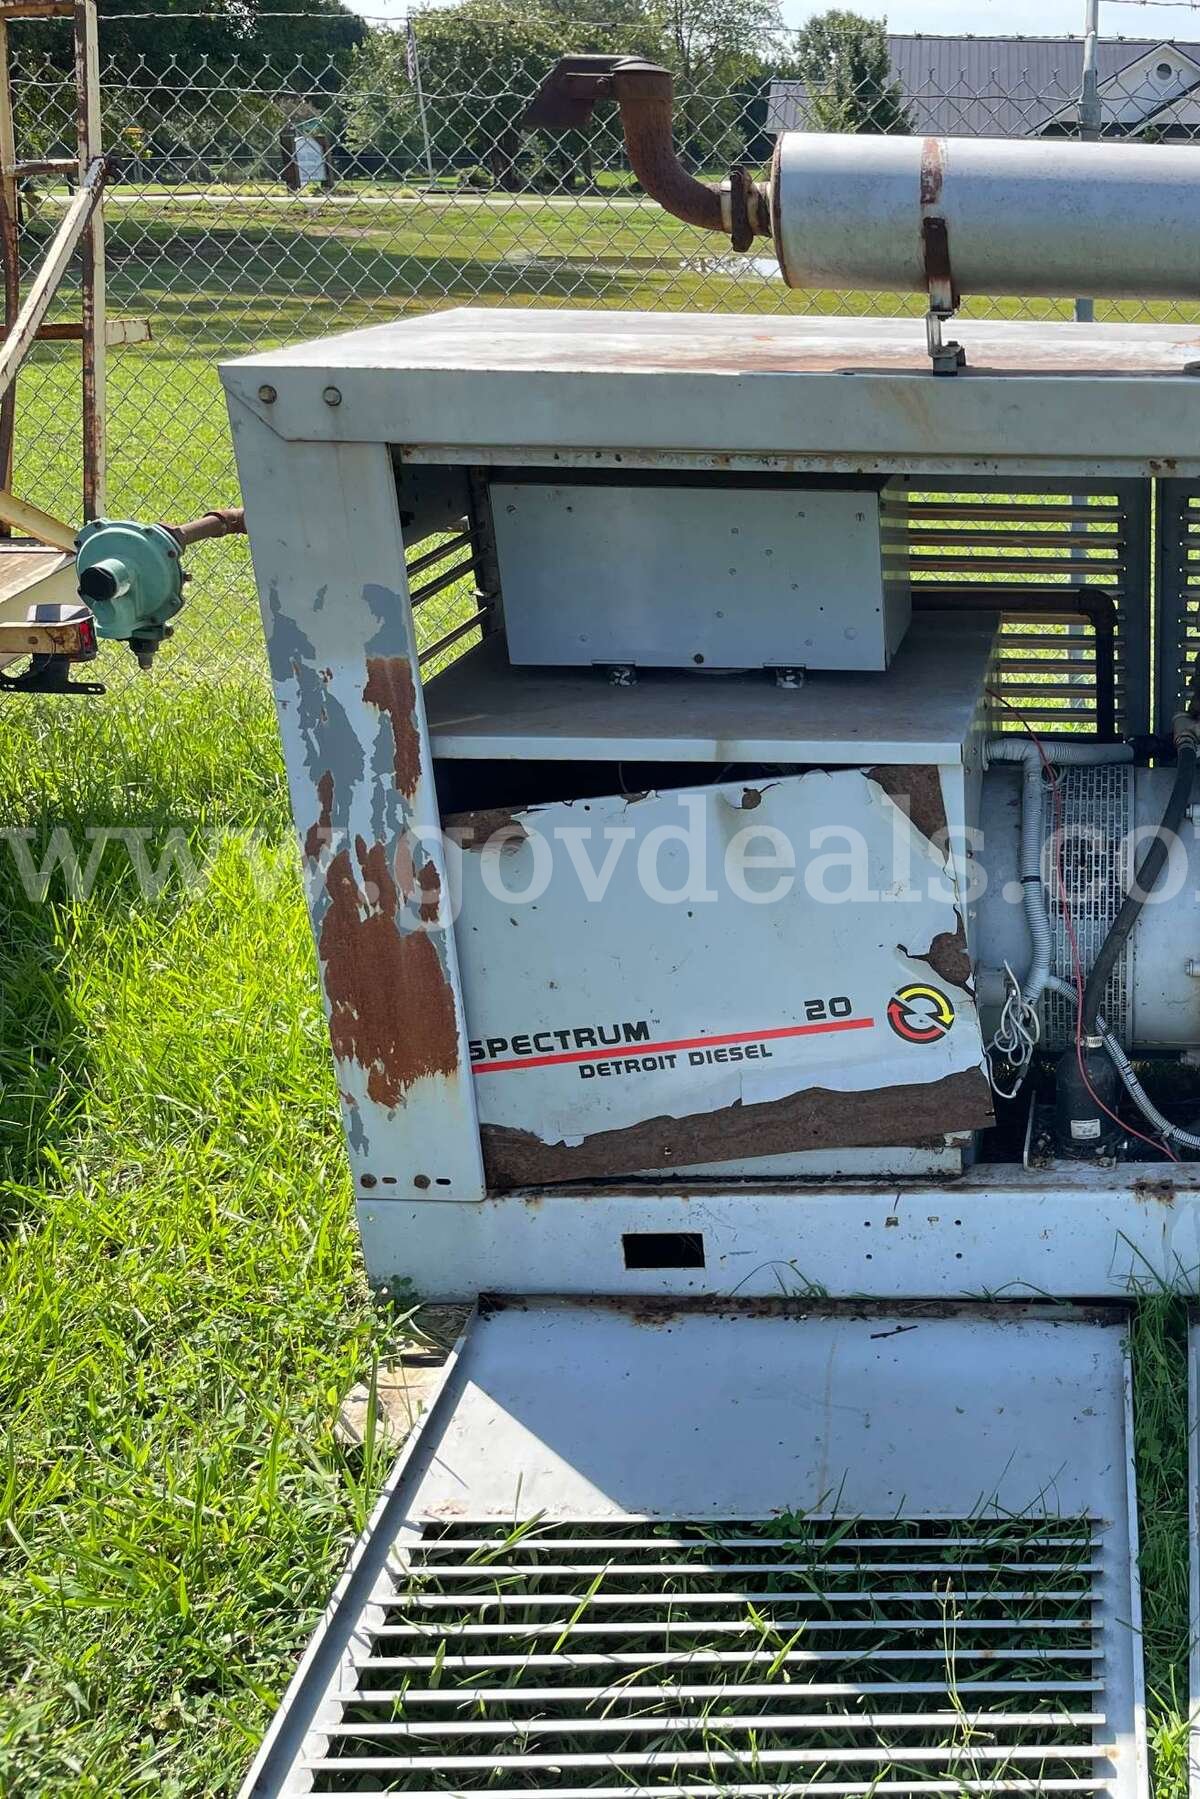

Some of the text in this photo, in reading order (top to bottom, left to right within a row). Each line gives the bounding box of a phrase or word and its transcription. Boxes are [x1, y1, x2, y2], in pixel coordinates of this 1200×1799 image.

[469, 1021, 650, 1061] SPECTRUM
[804, 996, 852, 1021] 20
[579, 1043, 773, 1079] DETROIT DIESEL
